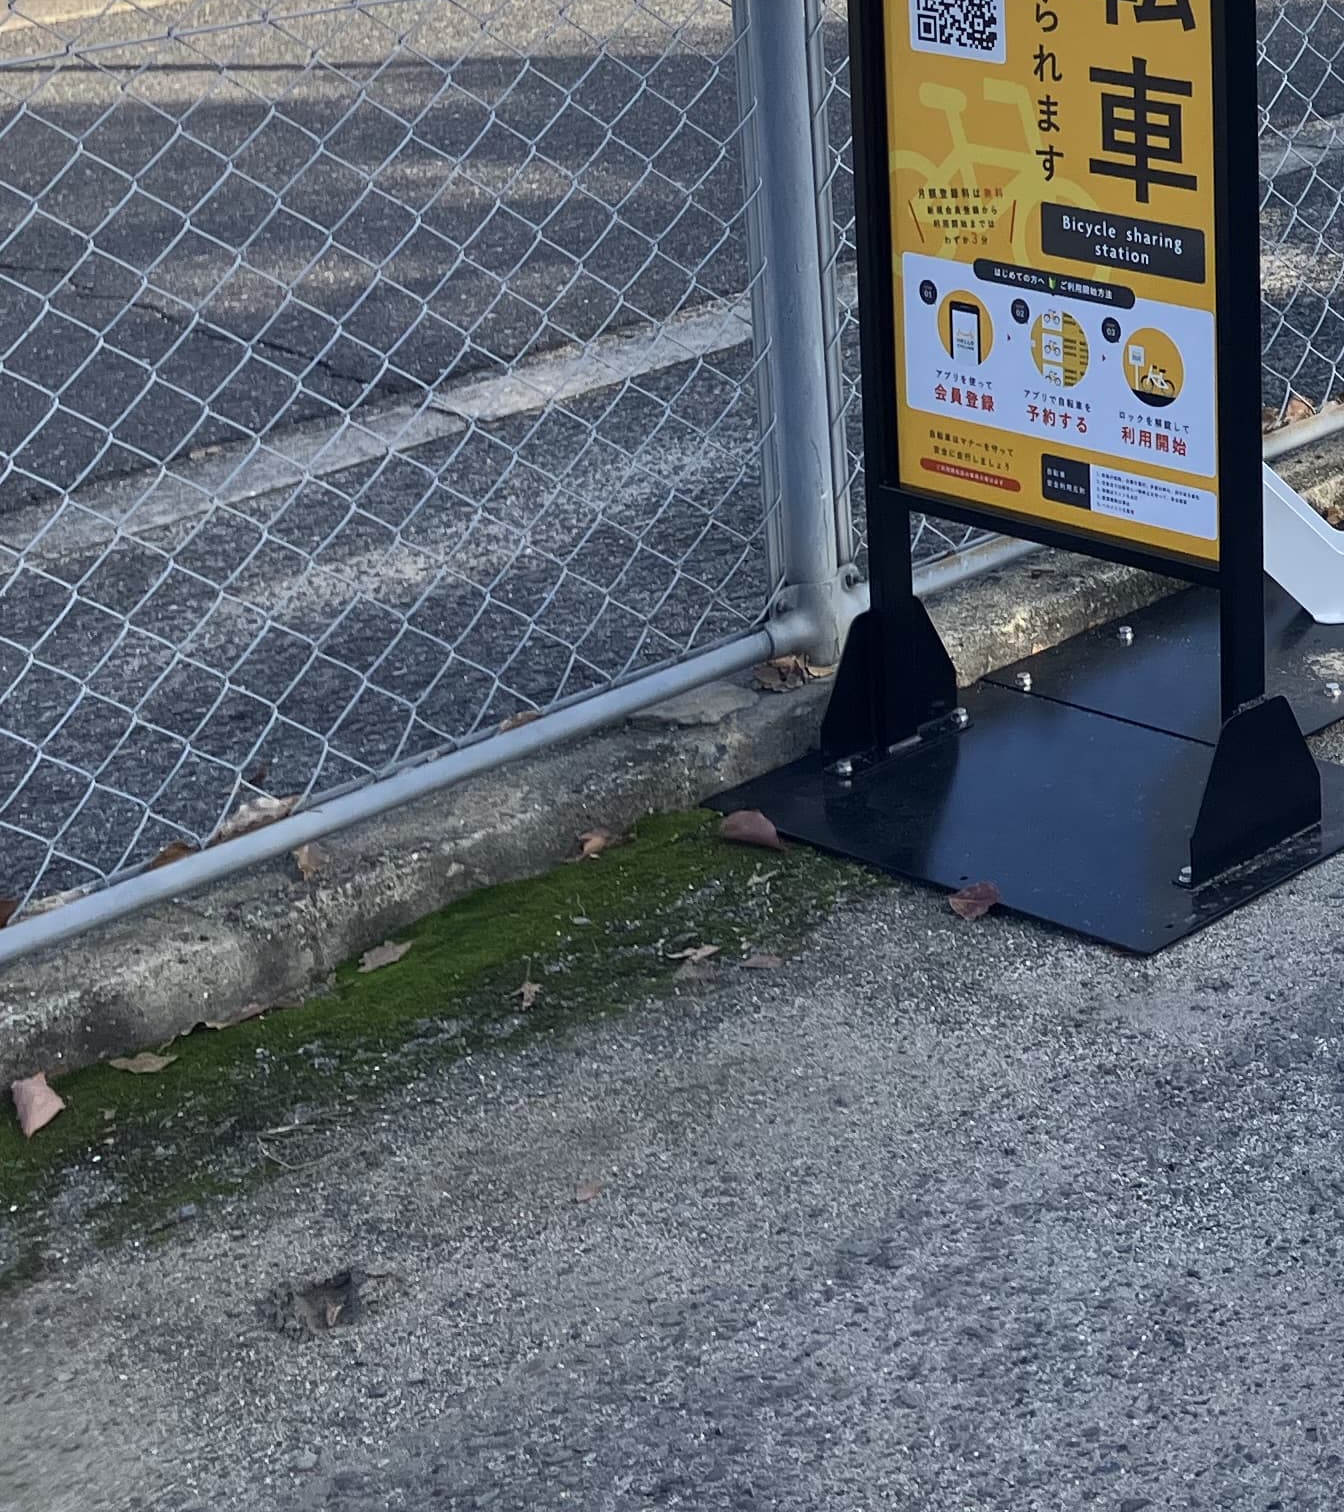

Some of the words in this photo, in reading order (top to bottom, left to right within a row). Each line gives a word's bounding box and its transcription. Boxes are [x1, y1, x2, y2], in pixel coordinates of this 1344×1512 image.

[1062, 215, 1116, 240] Bicycle
[1126, 226, 1183, 255] sharing
[1095, 243, 1150, 266] station
[993, 267, 1046, 285] はじめての方へ
[936, 369, 993, 390] アプリを使って
[934, 383, 995, 413] 会員登録
[1026, 404, 1088, 434] 予約する
[1121, 426, 1187, 457] 利用開始
